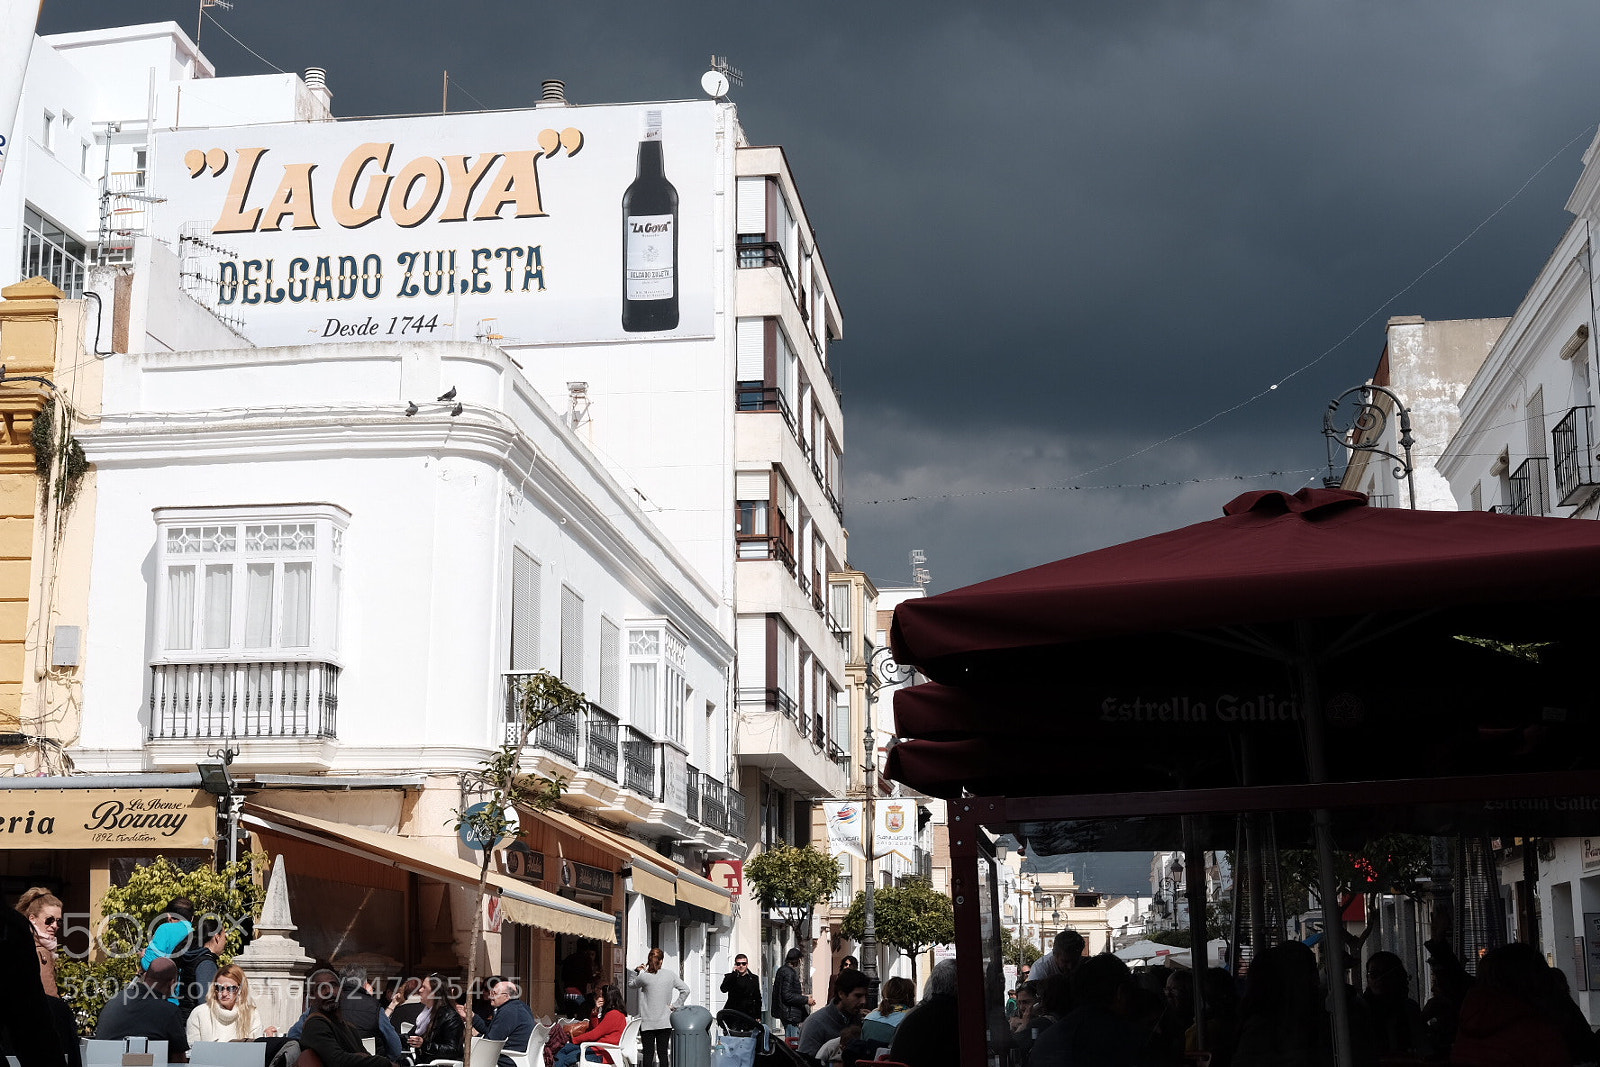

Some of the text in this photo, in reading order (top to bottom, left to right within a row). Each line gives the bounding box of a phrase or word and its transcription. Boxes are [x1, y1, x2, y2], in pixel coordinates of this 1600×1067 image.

[218, 245, 547, 306] DELGADO ZULETA
[321, 314, 438, 338] Desde 1744
[1100, 692, 1305, 721] Estrella Galici
[84, 800, 188, 837] Bornay
[126, 798, 144, 811] La
